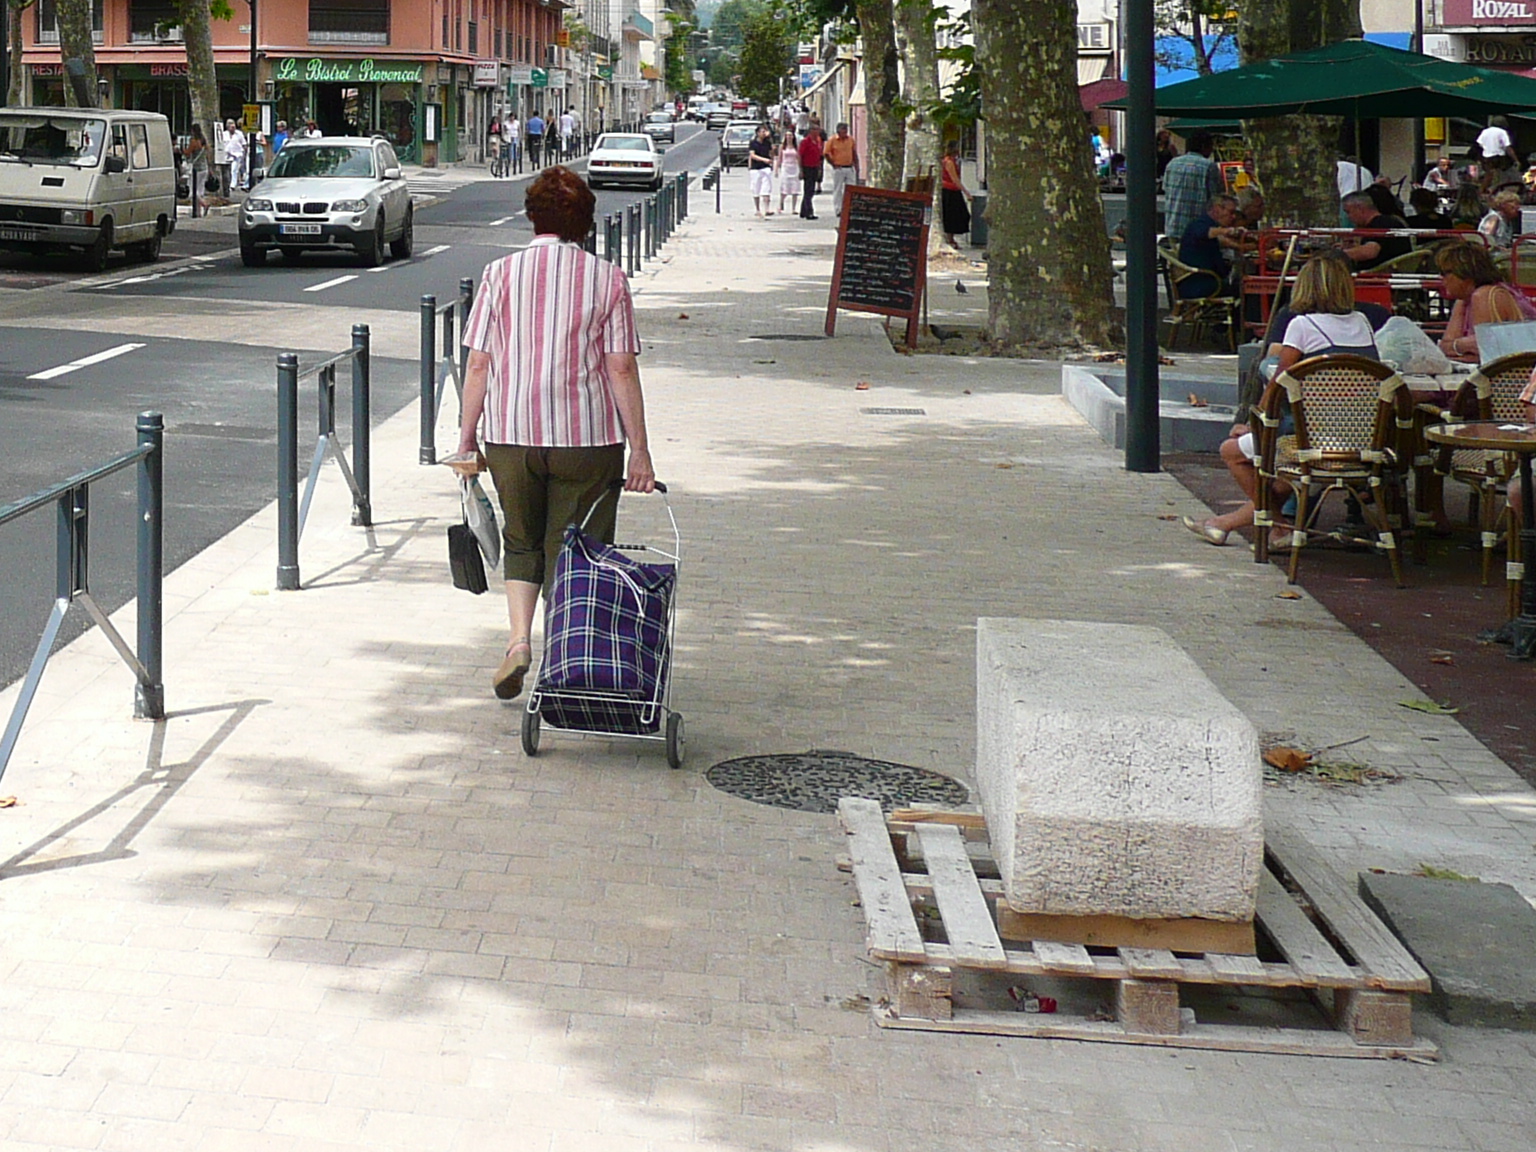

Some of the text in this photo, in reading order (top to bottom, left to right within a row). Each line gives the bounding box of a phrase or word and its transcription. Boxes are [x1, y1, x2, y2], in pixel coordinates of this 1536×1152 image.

[31, 64, 64, 76] RESTA
[150, 64, 189, 76] BRASS
[277, 58, 298, 80] Le
[305, 58, 353, 81] Bistrot
